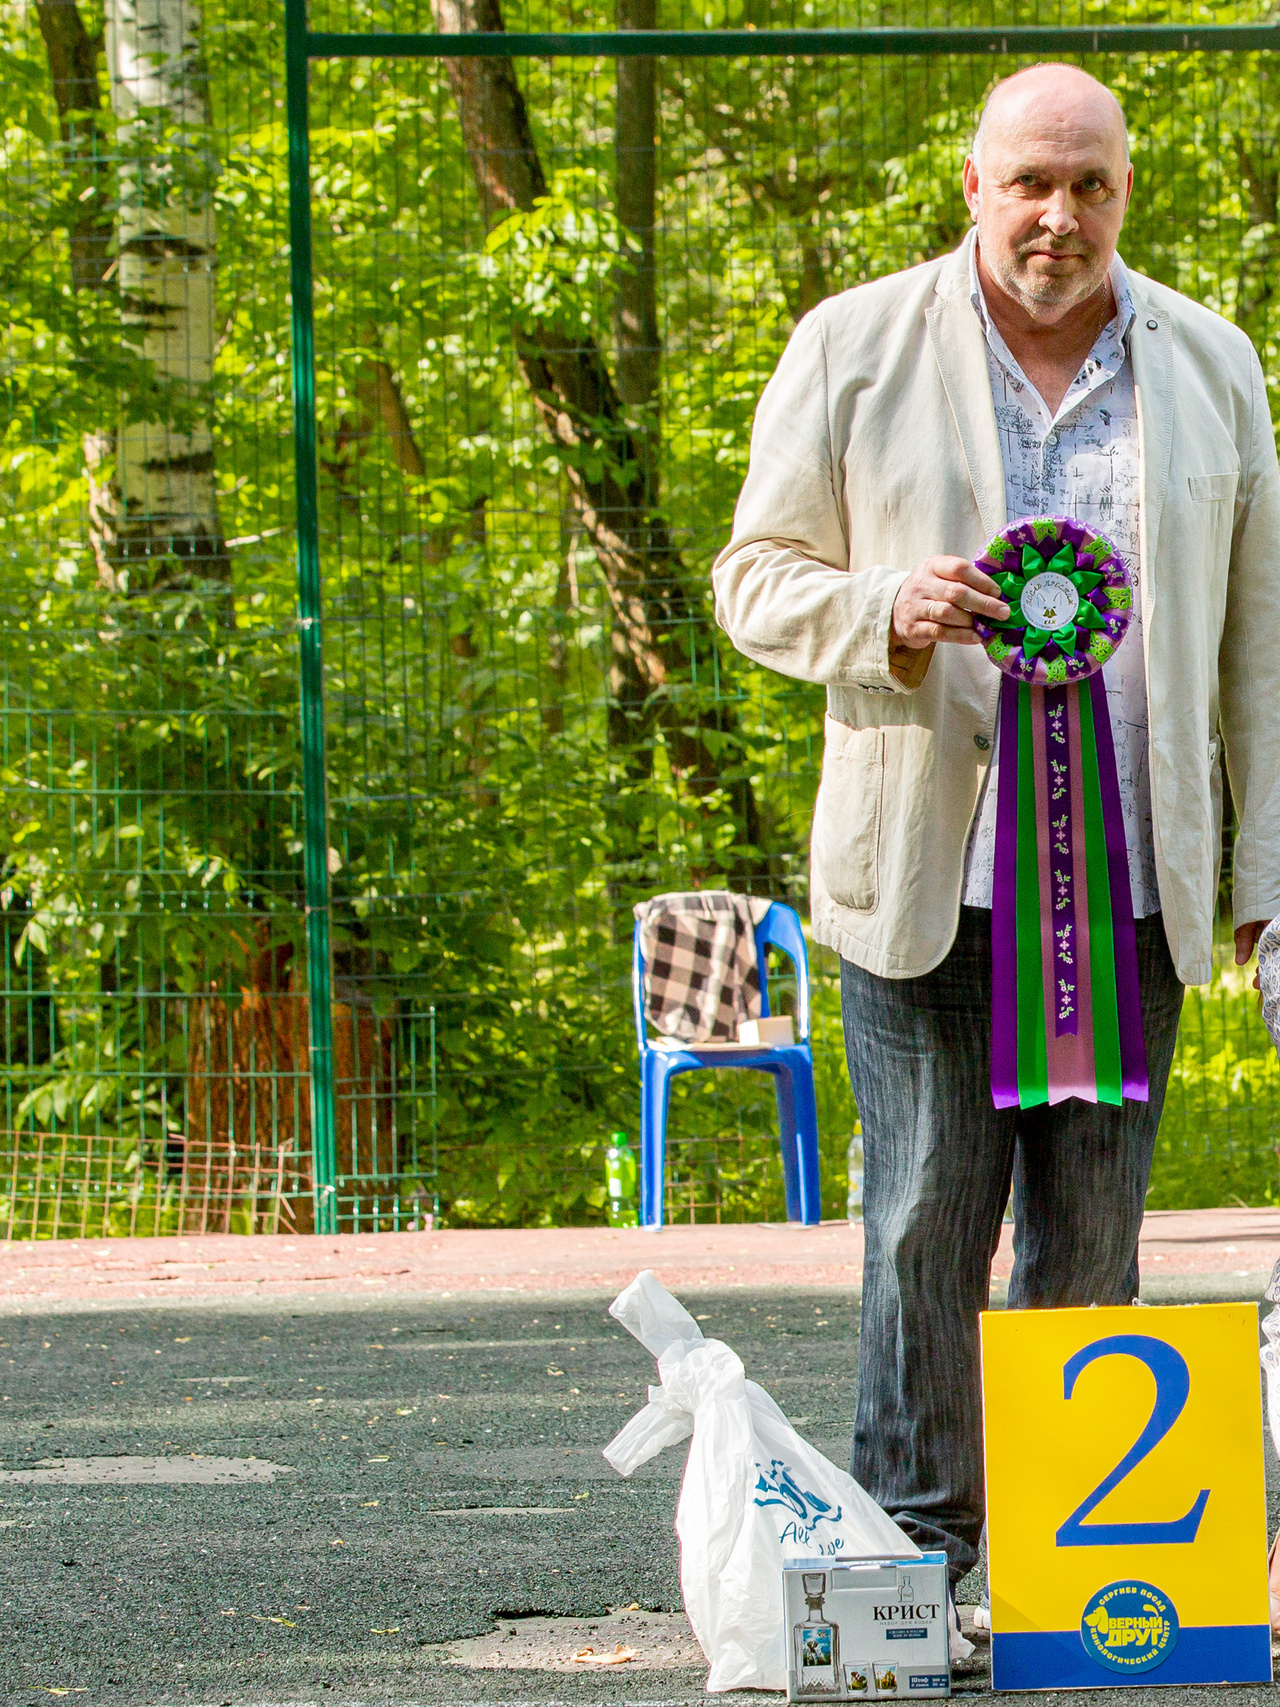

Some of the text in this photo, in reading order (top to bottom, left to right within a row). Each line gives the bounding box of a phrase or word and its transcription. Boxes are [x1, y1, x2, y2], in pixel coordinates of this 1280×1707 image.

[1055, 1334, 1211, 1547] 2
[1099, 1586, 1167, 1612] СЕРГИЕВ ПОСАД
[873, 1604, 941, 1620] КРИСТ
[1108, 1616, 1163, 1629] ВЕРНЫЙ
[1090, 1620, 1171, 1665] КИНОЛОГИЧЕСКИЙ ЦЕНТР
[1104, 1628, 1163, 1647] ДРУГ
